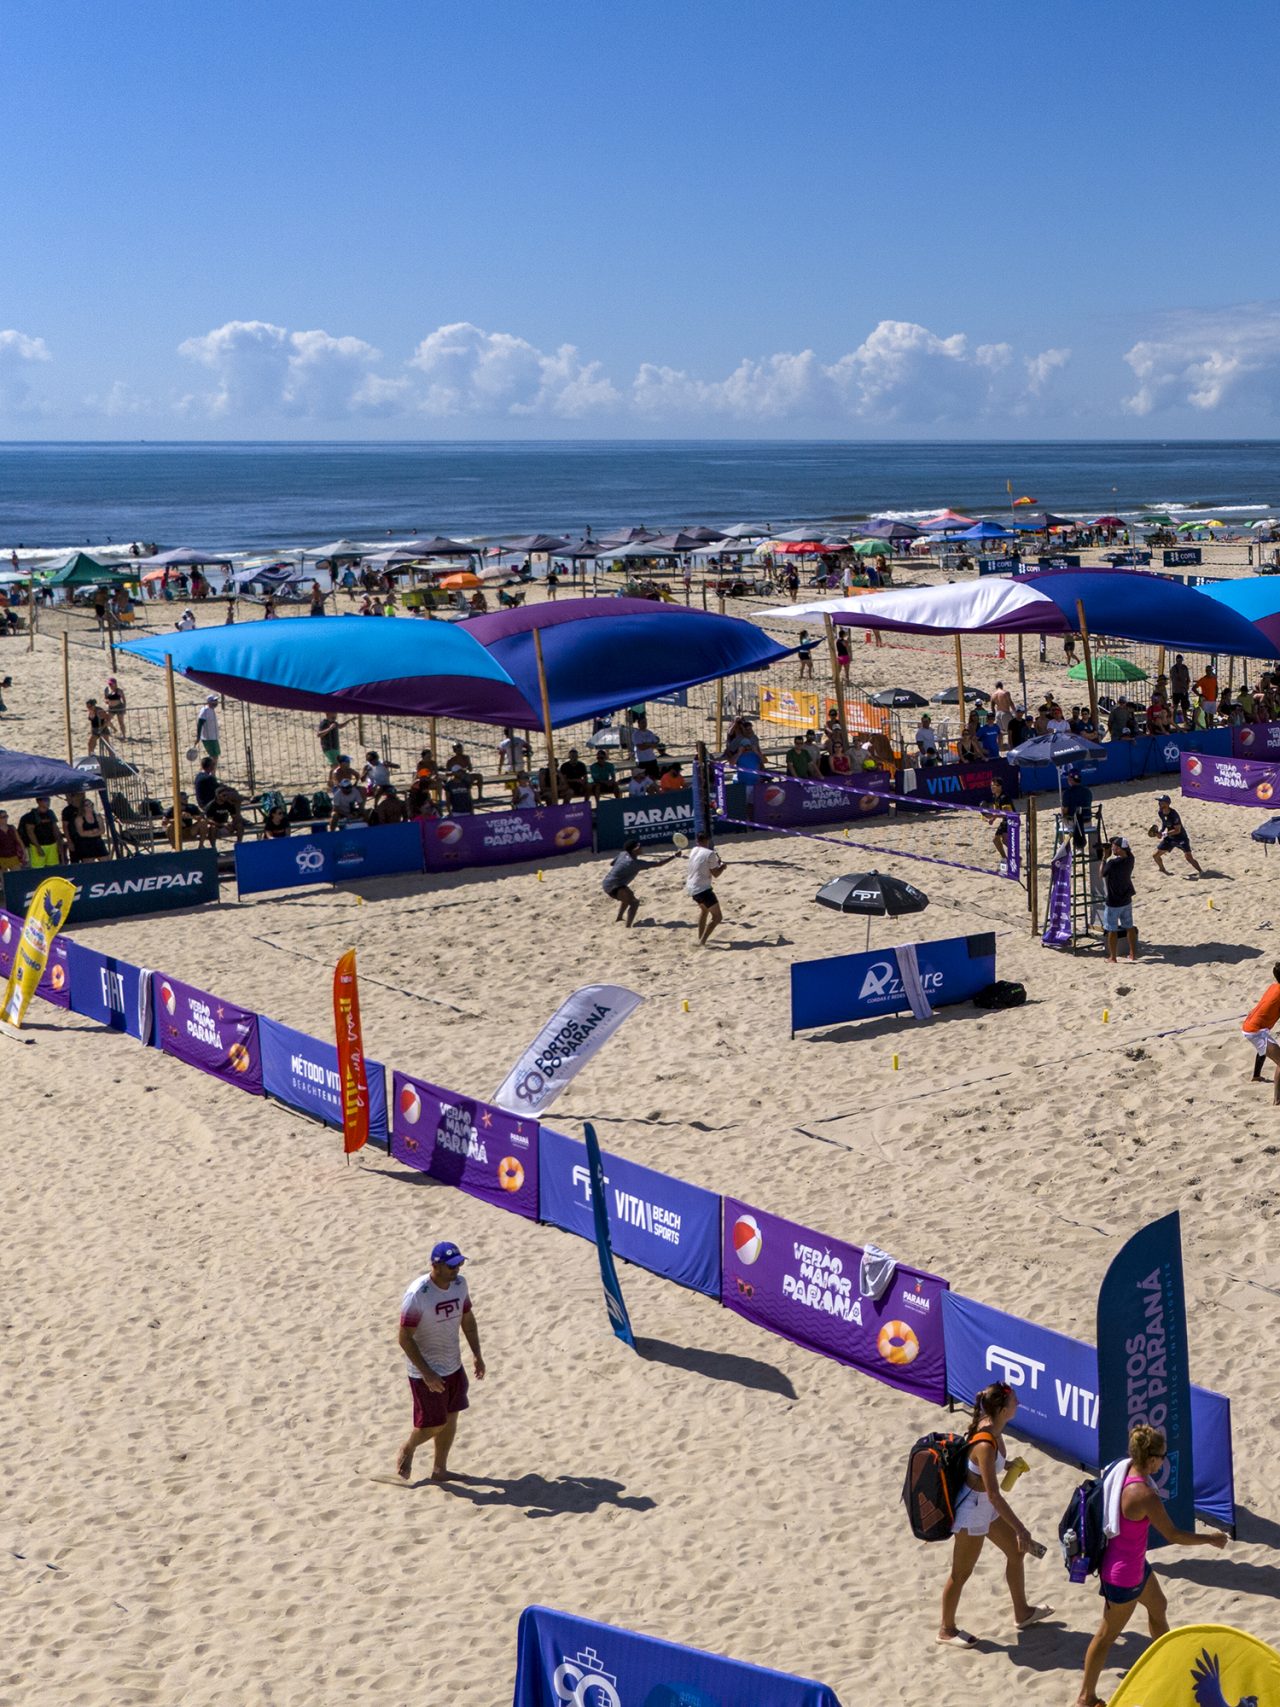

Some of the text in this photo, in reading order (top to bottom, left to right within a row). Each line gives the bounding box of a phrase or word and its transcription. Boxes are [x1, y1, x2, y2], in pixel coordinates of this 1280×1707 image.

[927, 775, 960, 795] VITA
[486, 816, 522, 828] VERÃO
[494, 823, 531, 834] MAIOR
[623, 804, 695, 827] PARAN
[484, 828, 543, 846] PARANÁ
[296, 851, 324, 870] 90
[90, 871, 203, 898] SANEPAR
[852, 889, 880, 900] FPT
[100, 967, 125, 1014] FIAT
[188, 998, 210, 1017] VERÃO
[186, 1020, 223, 1050] PARANÁ
[193, 1012, 215, 1032] MAIOR
[534, 1019, 579, 1069] PORTOS
[542, 1057, 563, 1078] DO
[561, 1003, 611, 1058] PARANÁ
[291, 1054, 324, 1085] MÉTODO
[293, 1078, 341, 1106] BEACHTENNI
[516, 1071, 545, 1104] 90
[439, 1102, 471, 1124] VERÃO
[446, 1119, 478, 1142] MAIOR
[437, 1128, 488, 1164] PARANÁ
[614, 1189, 681, 1231] VITA BEACH
[653, 1223, 680, 1246] SPORTS
[793, 1242, 843, 1275] VERÃO
[800, 1264, 852, 1298] MAIOR
[435, 1298, 460, 1318] FPT
[782, 1273, 863, 1326] PARANÁ
[903, 1291, 930, 1311] PARANÁ
[1136, 1267, 1168, 1398] PARANÁ
[986, 1344, 1045, 1389] FPT
[1126, 1333, 1148, 1432] ORTOS
